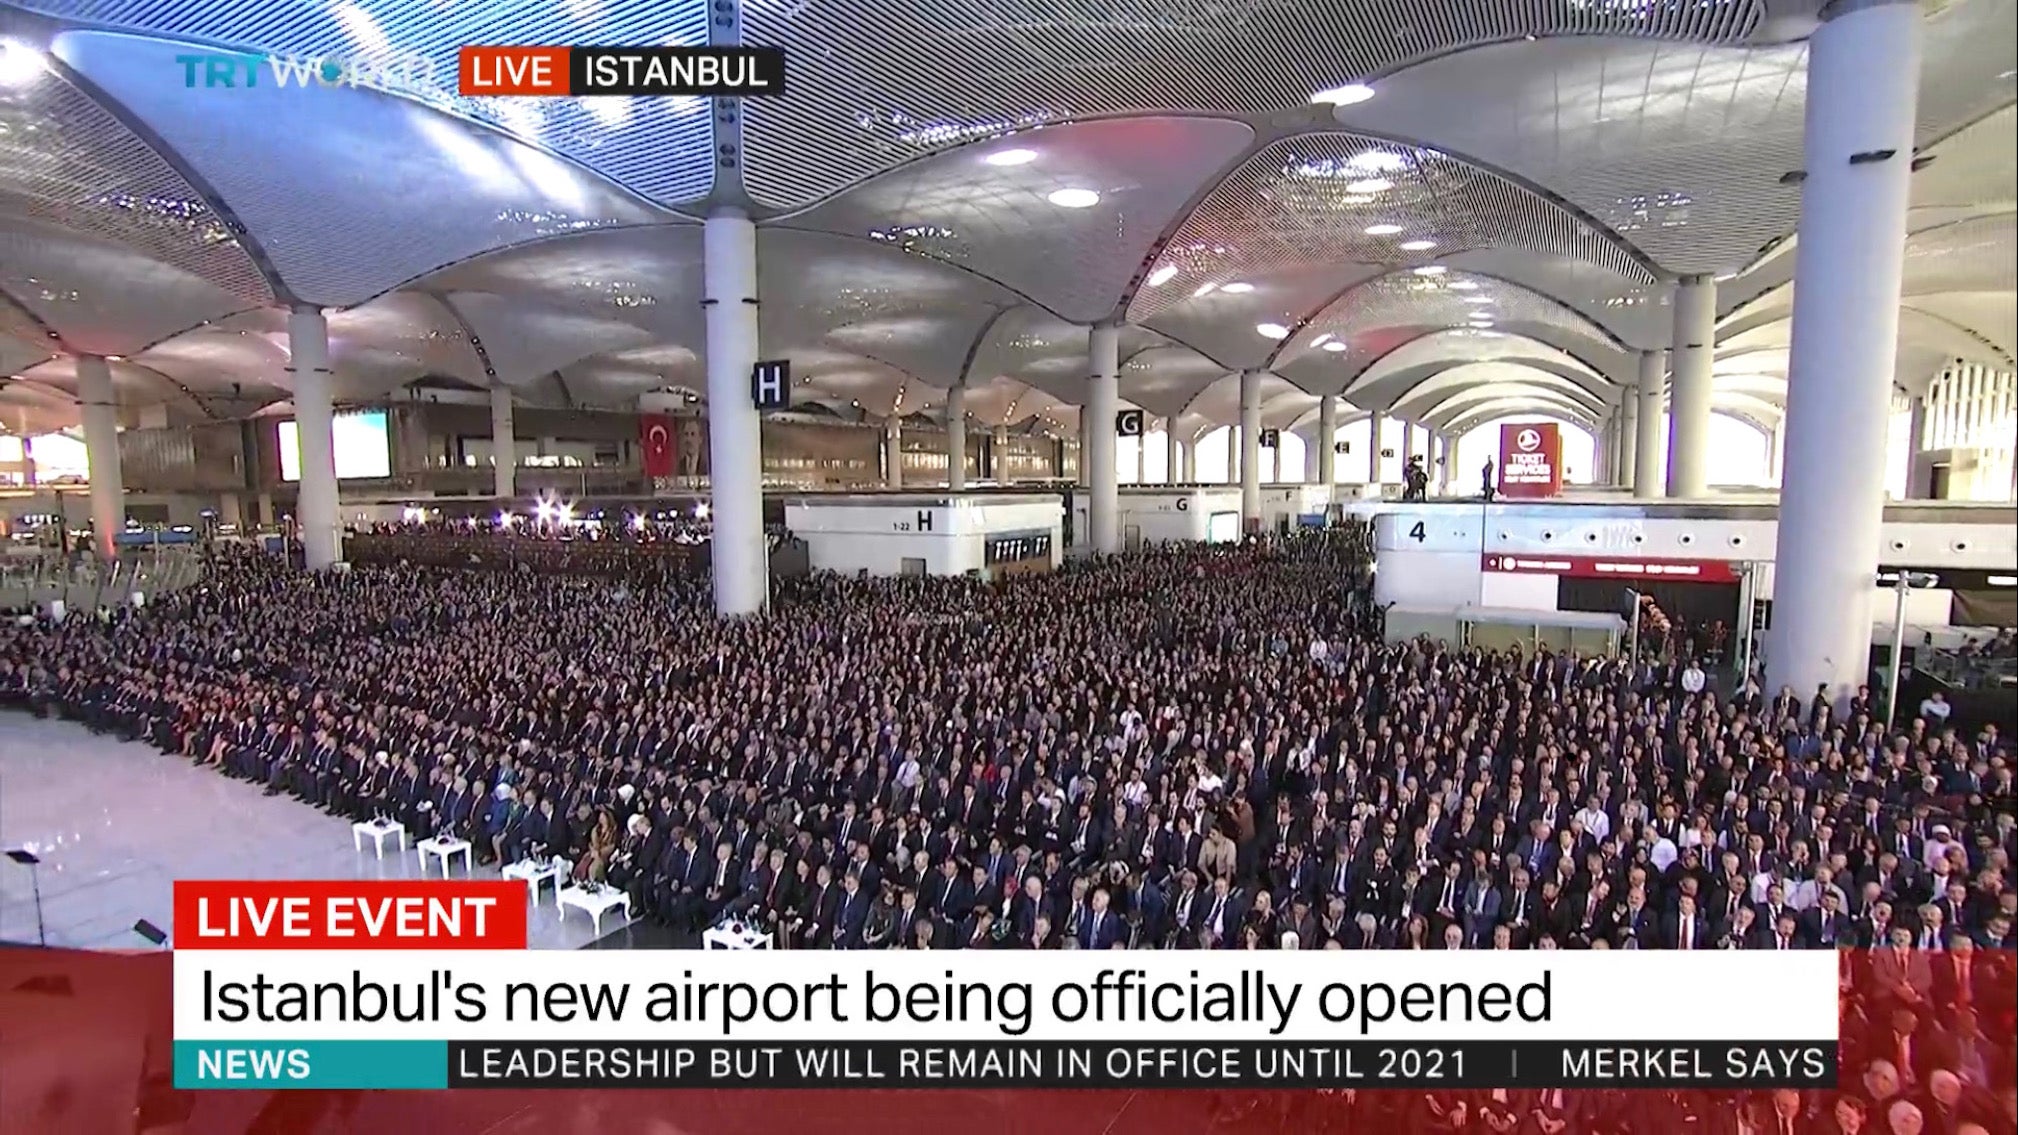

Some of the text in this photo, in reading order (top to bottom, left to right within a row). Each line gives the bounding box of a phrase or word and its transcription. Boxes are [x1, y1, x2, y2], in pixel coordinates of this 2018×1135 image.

[759, 366, 781, 404] H
[1122, 413, 1139, 438] G
[1176, 497, 1188, 511] G
[918, 510, 932, 531] H
[1409, 520, 1427, 543] 4
